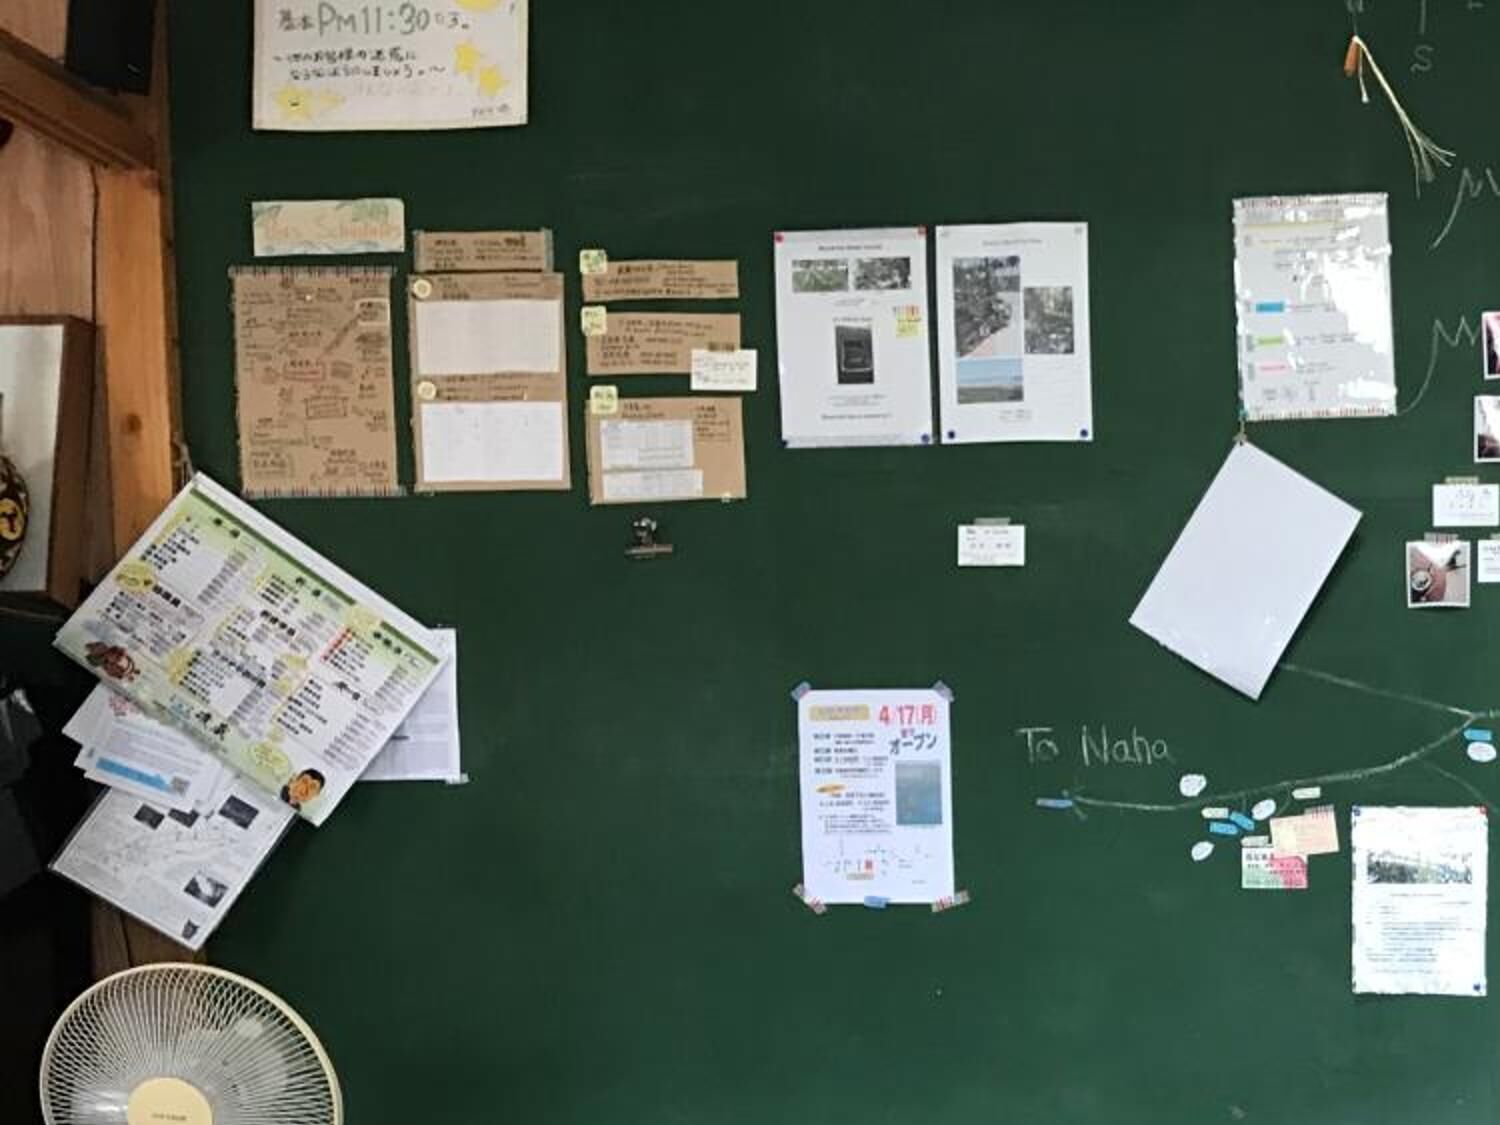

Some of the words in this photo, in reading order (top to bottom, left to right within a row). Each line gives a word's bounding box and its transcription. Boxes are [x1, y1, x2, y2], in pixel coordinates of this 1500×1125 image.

[888, 733, 938, 755] オープン
[1015, 726, 1060, 764] To
[1081, 724, 1178, 767] Naha
